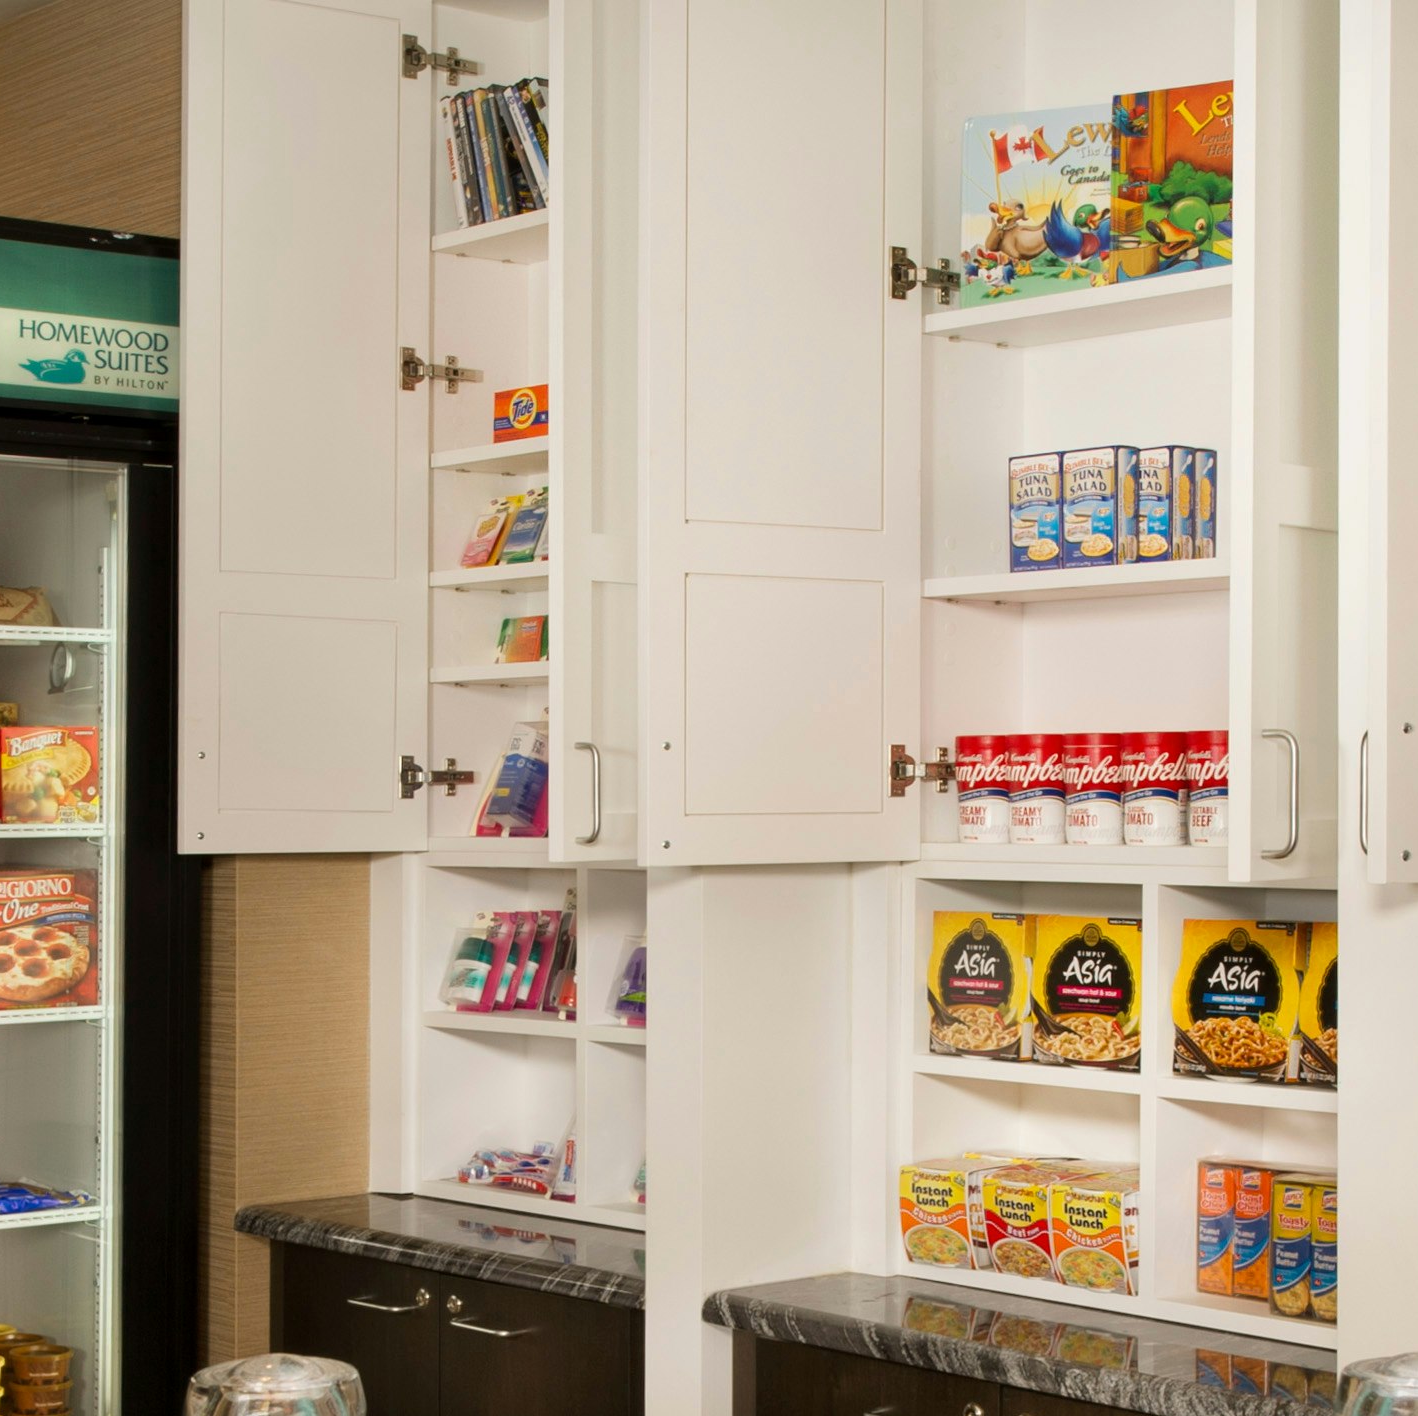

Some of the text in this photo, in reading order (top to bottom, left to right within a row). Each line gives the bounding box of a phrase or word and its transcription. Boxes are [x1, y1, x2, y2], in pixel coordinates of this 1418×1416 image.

[1031, 121, 1114, 165] Lew
[1060, 164, 1099, 178] Goes to
[1067, 171, 1111, 186] Canada
[18, 318, 170, 353] HOMEWOOD
[94, 348, 170, 376] SUITES
[94, 375, 111, 385] BY
[511, 397, 535, 423] Tide
[1018, 474, 1049, 488] TUNA
[1072, 468, 1104, 483] TUNA
[1016, 486, 1053, 500] SALAD
[1069, 480, 1107, 495] SALAD
[1191, 815, 1213, 827] BEEF
[2, 898, 40, 924] One
[965, 943, 991, 951] SIMPLY
[1077, 950, 1107, 959] SIMPLY
[954, 949, 997, 979] Asia
[1223, 955, 1254, 964] SIMPLY
[1062, 955, 1113, 986] Asia
[1207, 961, 1261, 993] Asia
[911, 1182, 953, 1198] Instant
[916, 1193, 950, 1209] Lunch
[994, 1194, 1036, 1213] Instant
[999, 1207, 1032, 1223] Lunch
[1063, 1202, 1108, 1220] Instant
[1069, 1215, 1104, 1231] Lunch
